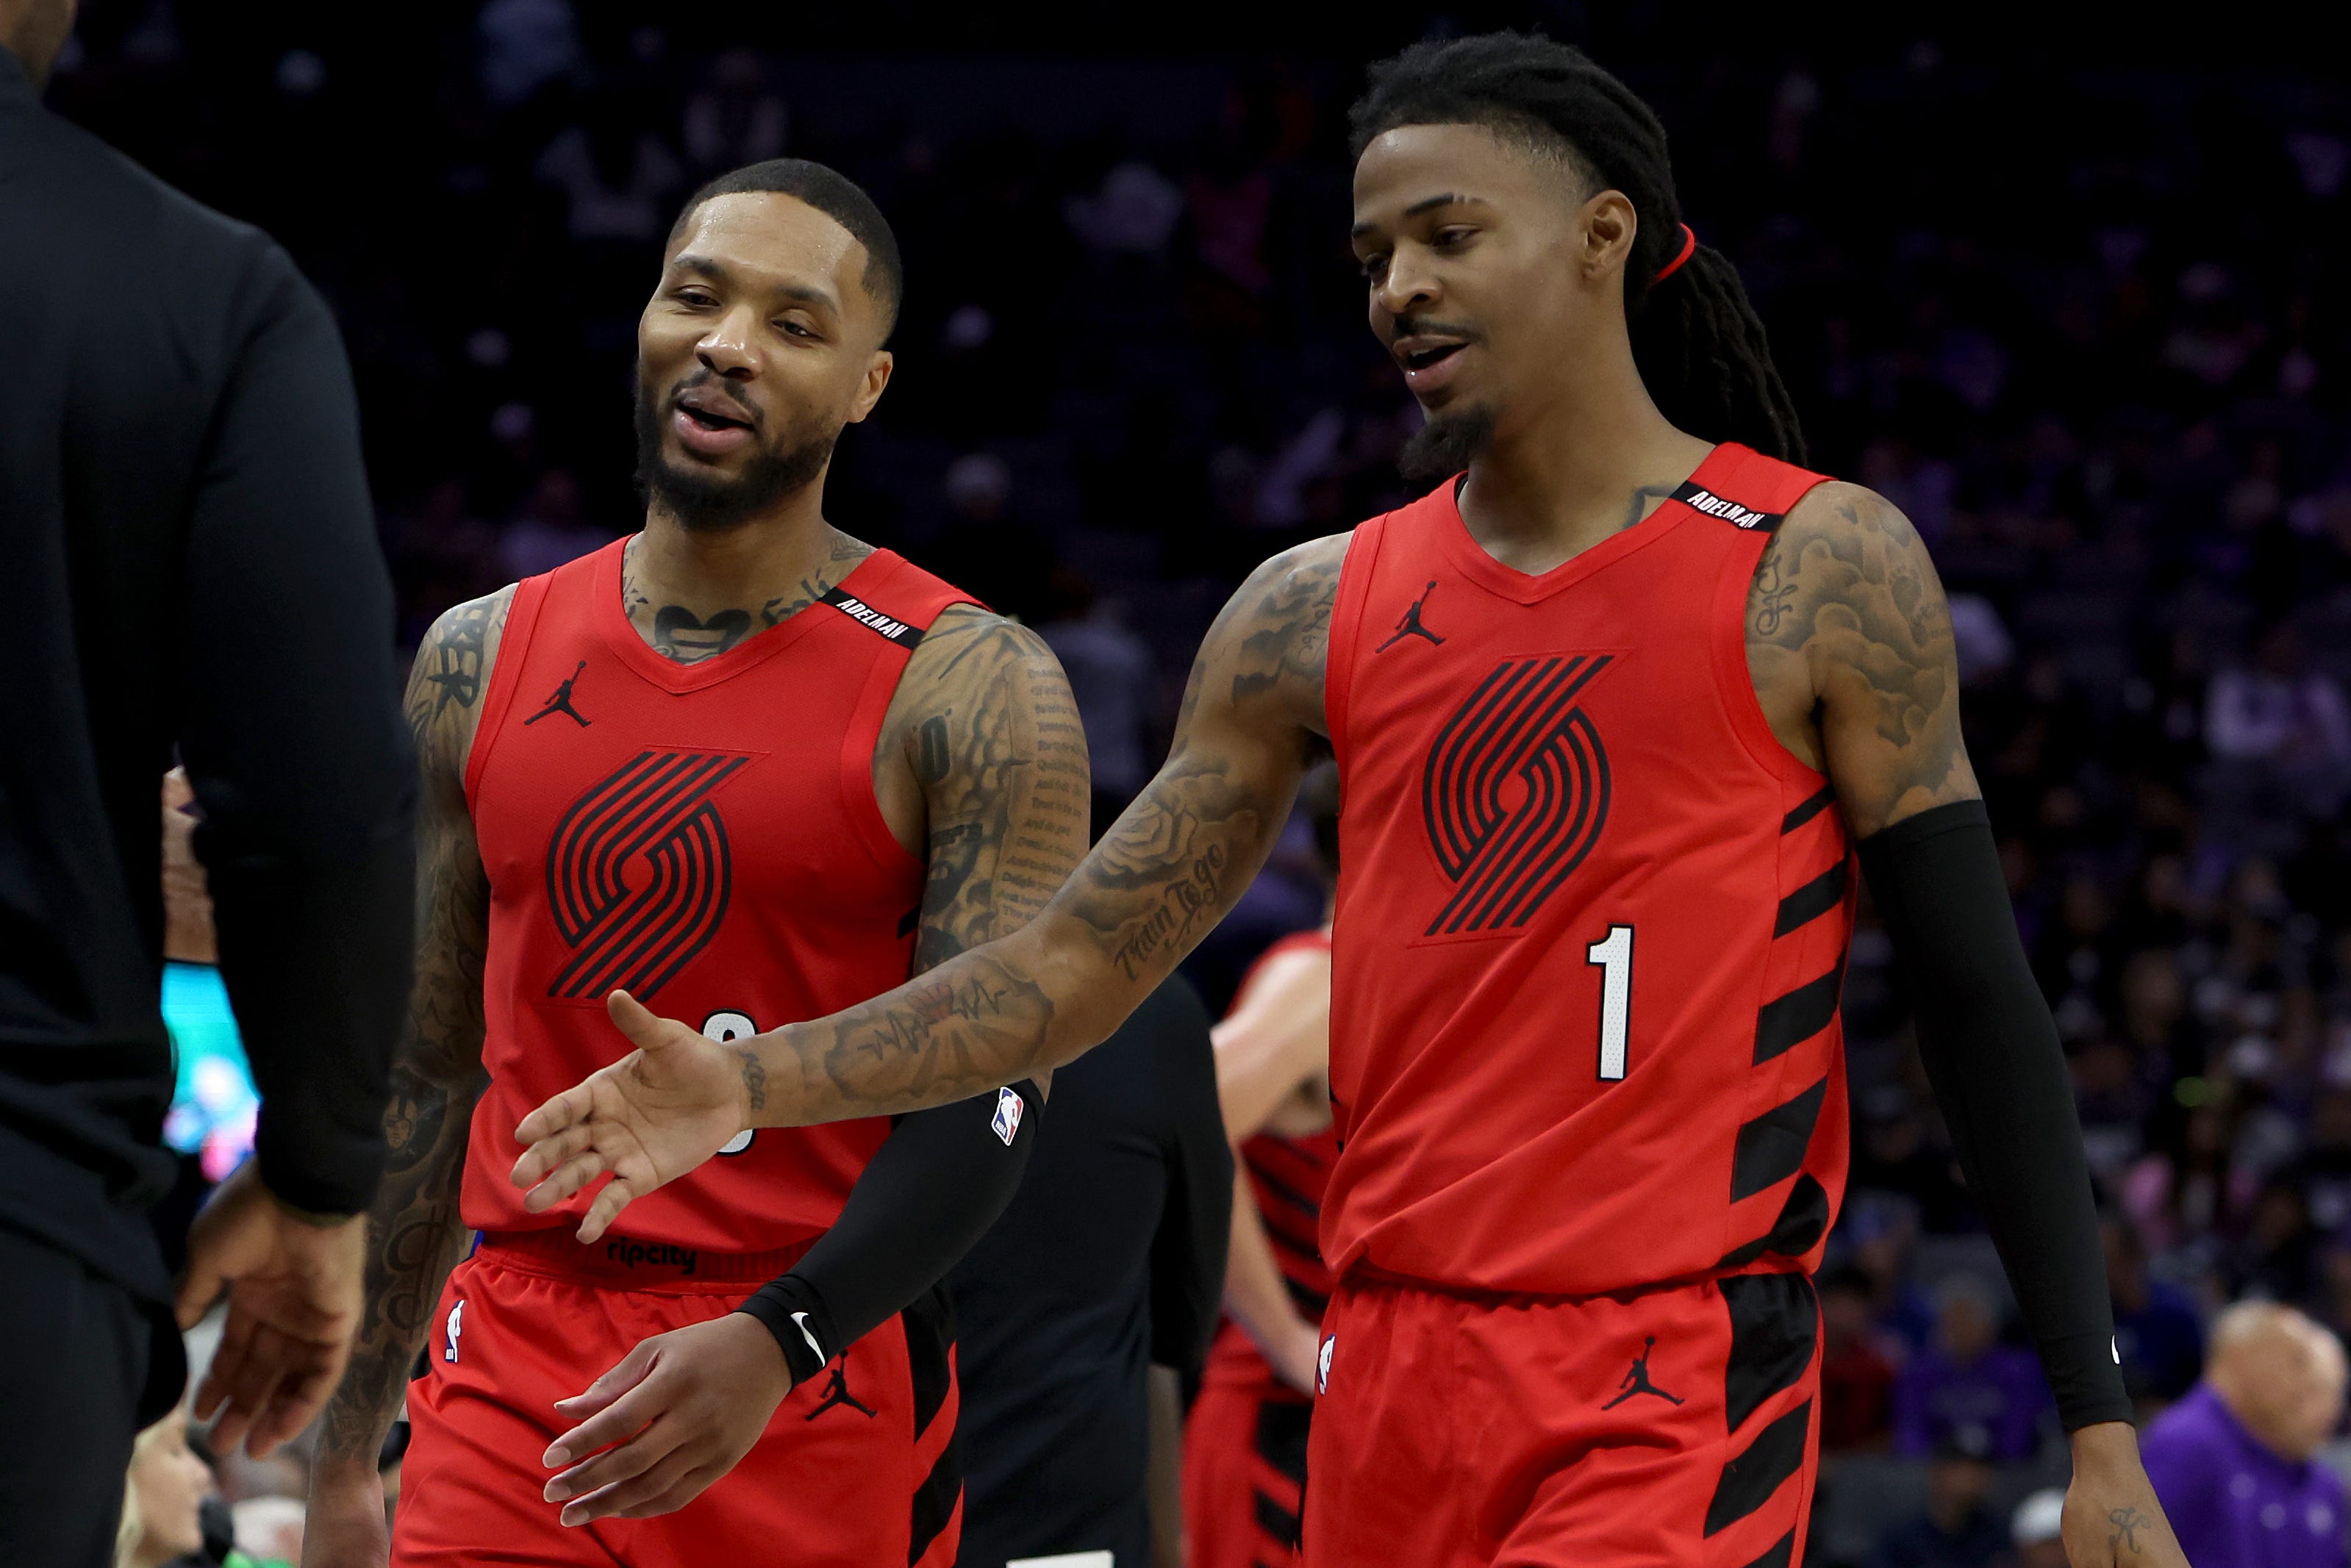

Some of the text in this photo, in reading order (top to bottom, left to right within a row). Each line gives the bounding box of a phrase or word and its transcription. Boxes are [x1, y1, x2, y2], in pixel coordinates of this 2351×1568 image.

[1686, 490, 1766, 529] ADELMAN
[835, 598, 909, 639] ADELMAN
[1587, 923, 1634, 1081] 1
[995, 1120, 1007, 1136] NBA
[606, 1236, 697, 1275] ripcity
